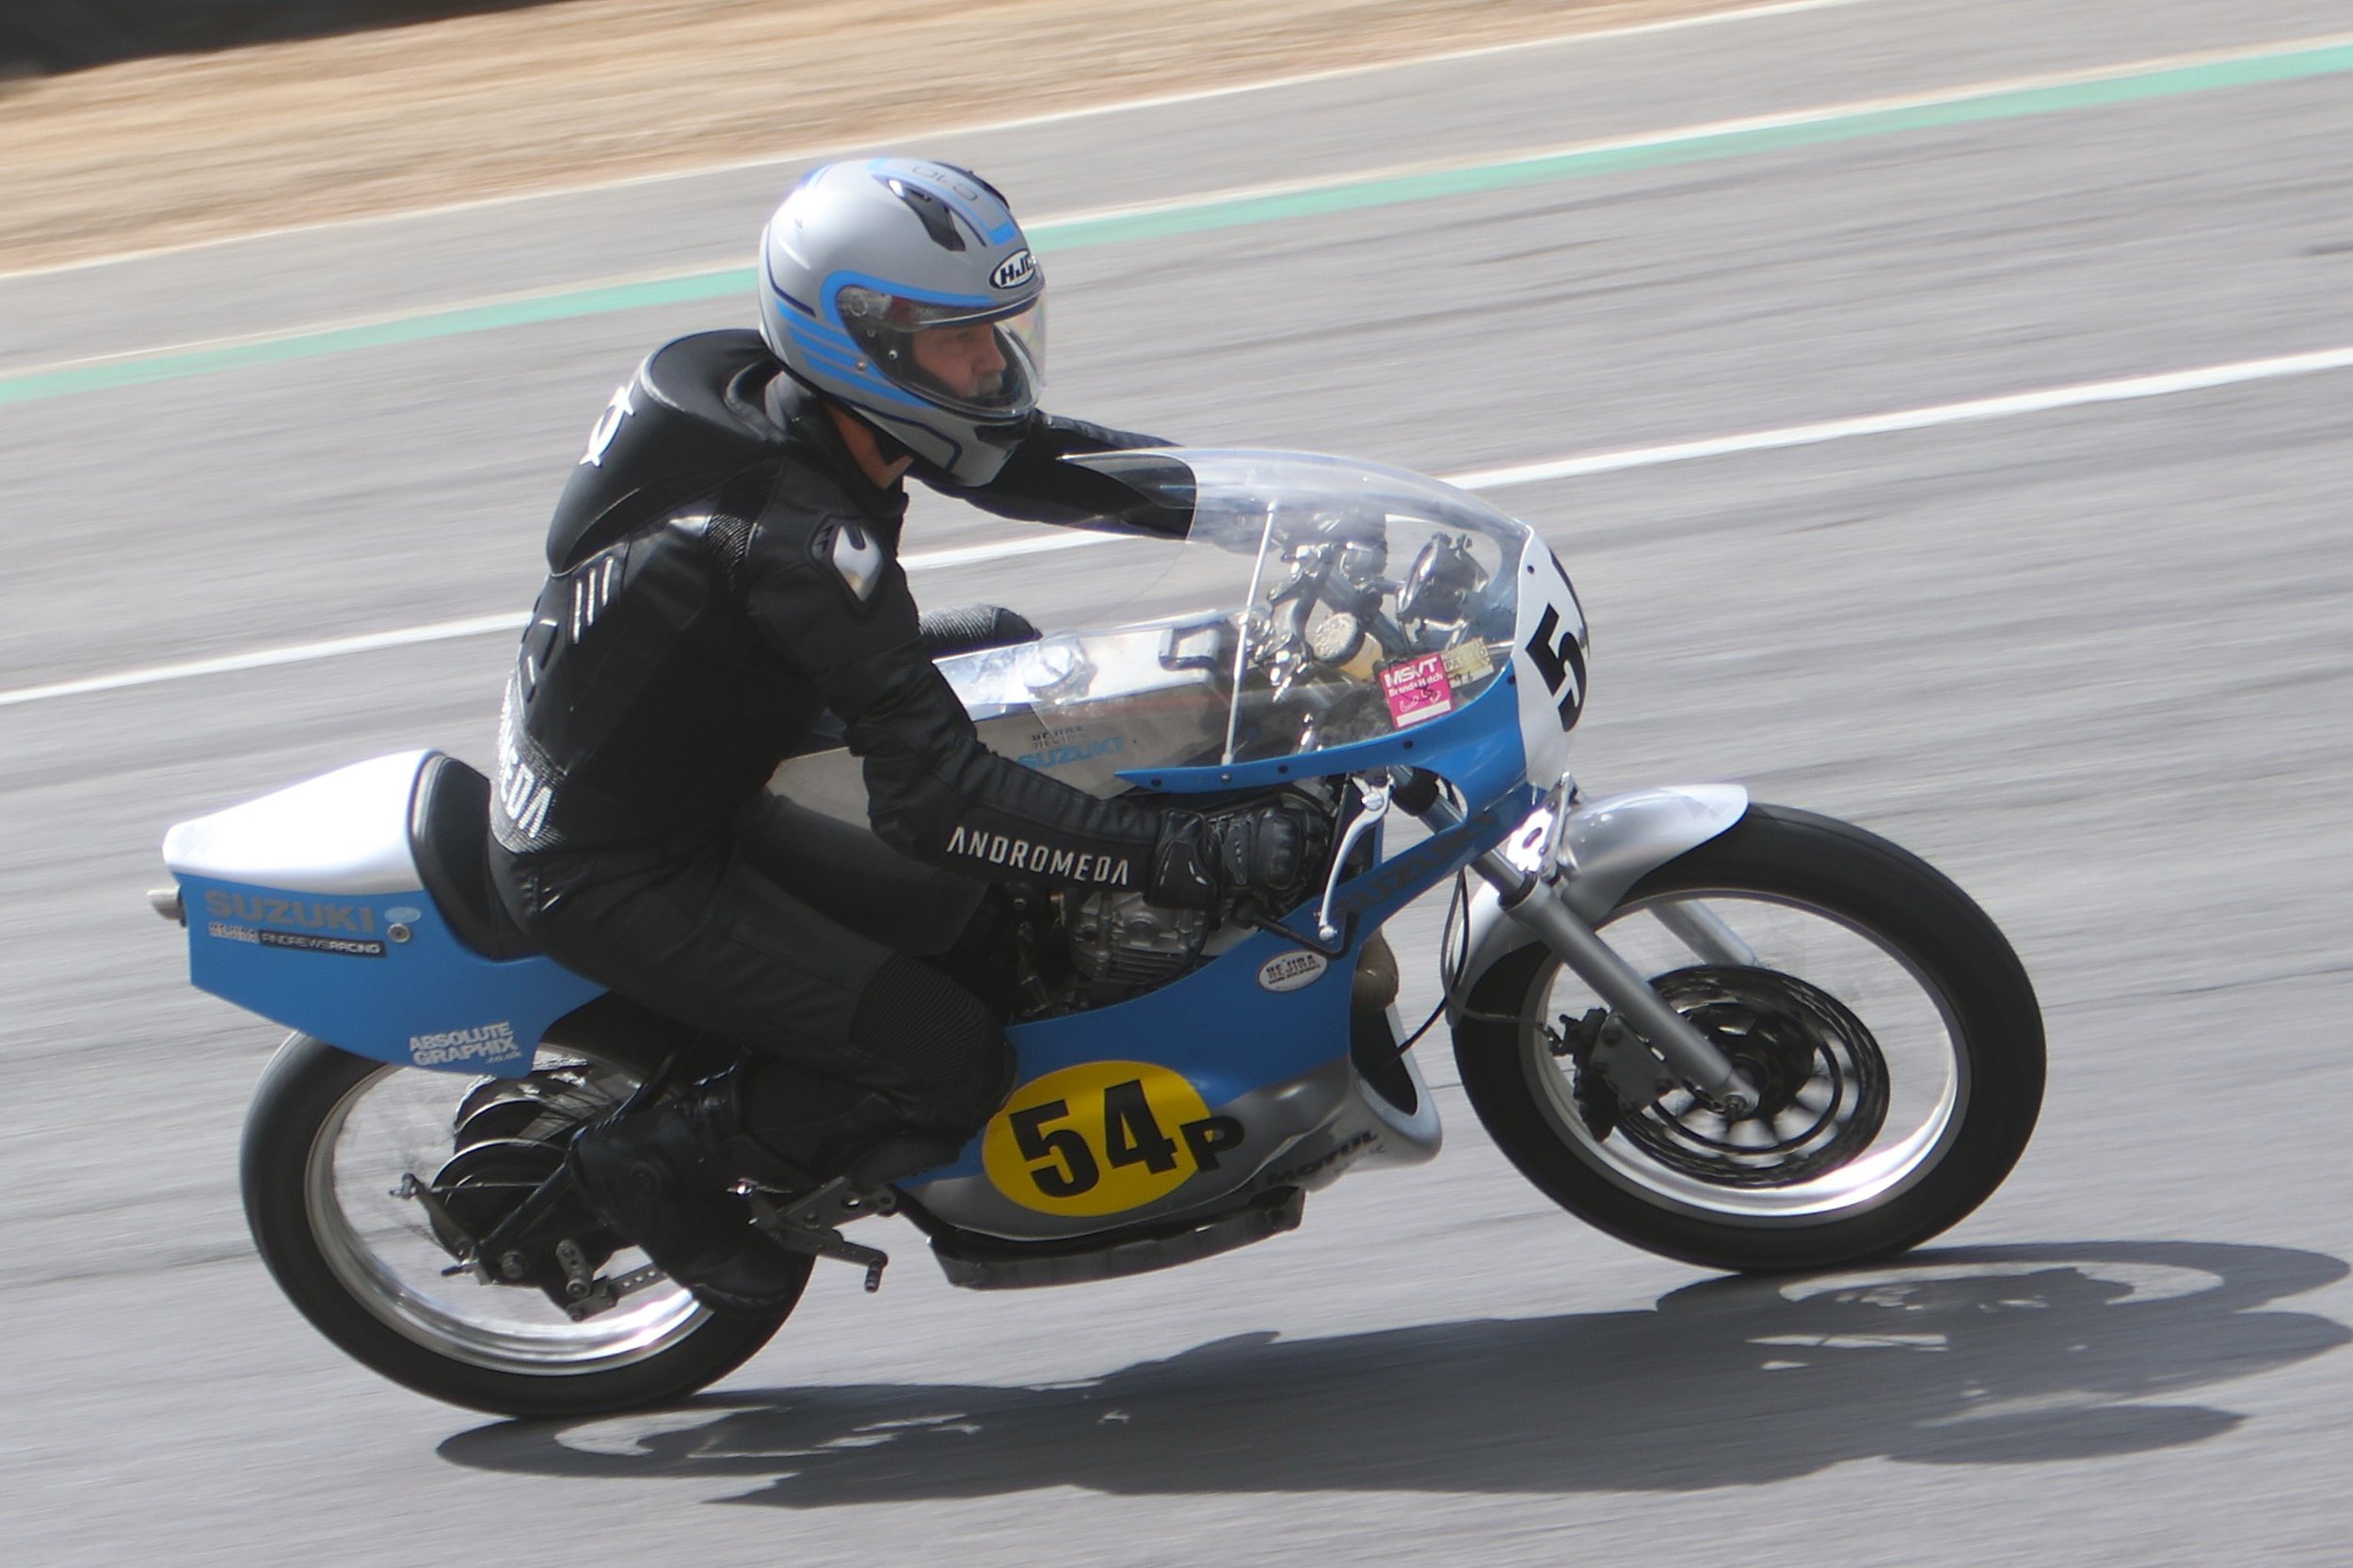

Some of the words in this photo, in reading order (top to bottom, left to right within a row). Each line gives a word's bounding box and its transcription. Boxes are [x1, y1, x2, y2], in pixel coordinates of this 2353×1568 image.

[1525, 544, 1590, 732] 5
[1384, 657, 1438, 687] MSVT
[947, 825, 1128, 886] ANDROMEDA
[205, 888, 375, 935] SUZUKI
[408, 1021, 514, 1051] ABSOLUTE
[413, 1035, 520, 1066] GRAPHIX
[1009, 1080, 1178, 1198] 54
[1179, 1115, 1245, 1172] P
